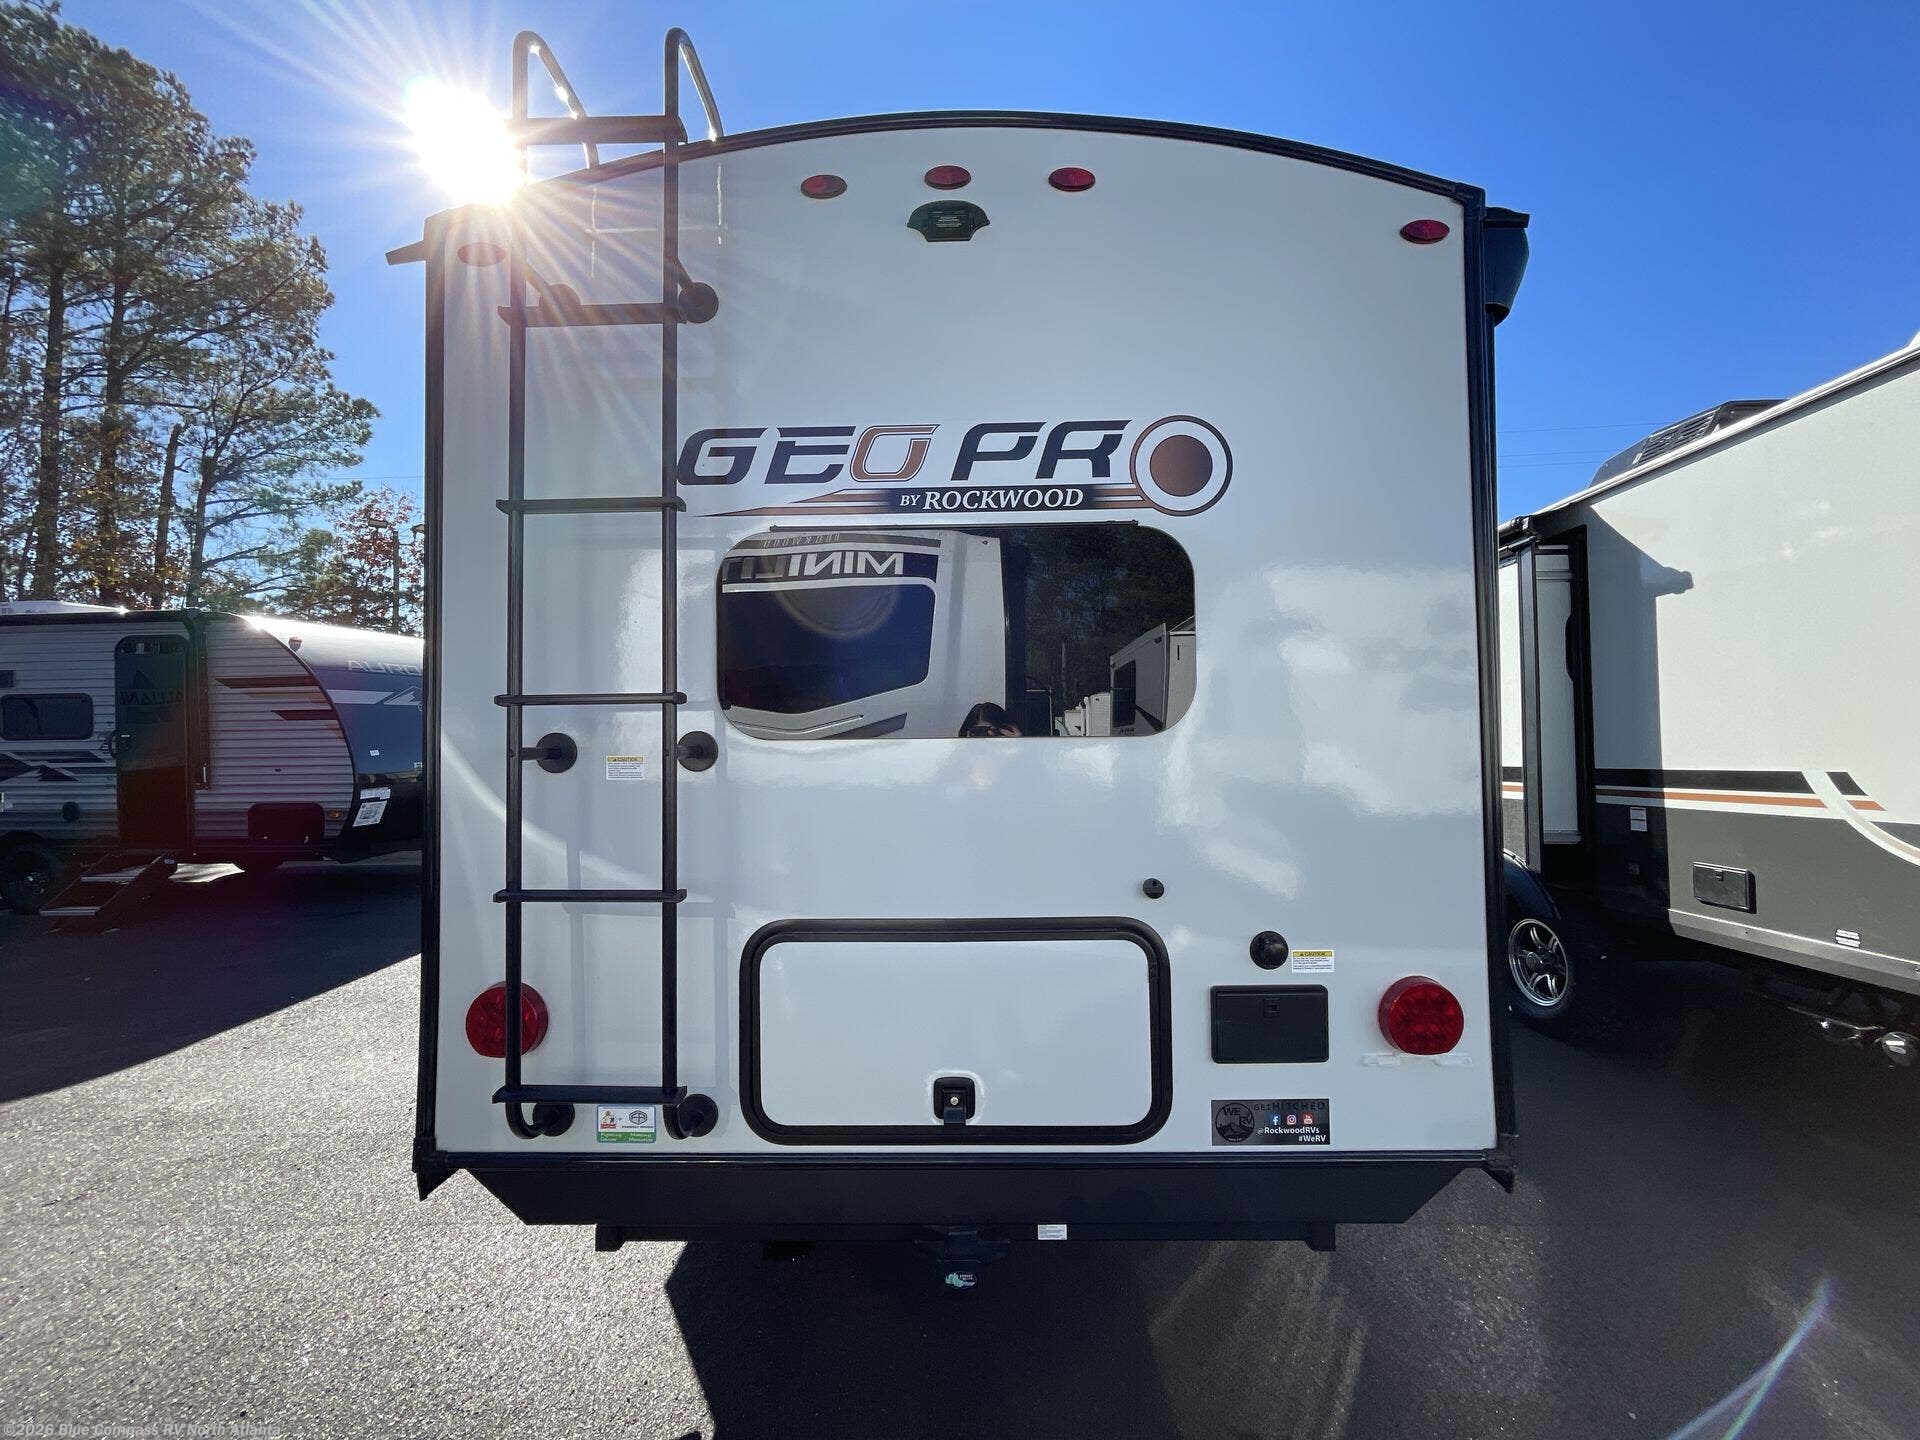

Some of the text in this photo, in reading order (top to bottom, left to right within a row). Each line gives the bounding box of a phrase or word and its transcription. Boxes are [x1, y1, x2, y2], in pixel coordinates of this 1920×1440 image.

[676, 424, 941, 486] GEO
[900, 488, 1084, 510] BY ROCKWOOD
[1223, 1107, 1241, 1117] WE
[1238, 1114, 1253, 1126] RV
[1257, 1126, 1321, 1135] @RockwoodRVs
[1298, 1134, 1327, 1143] #WeRV
